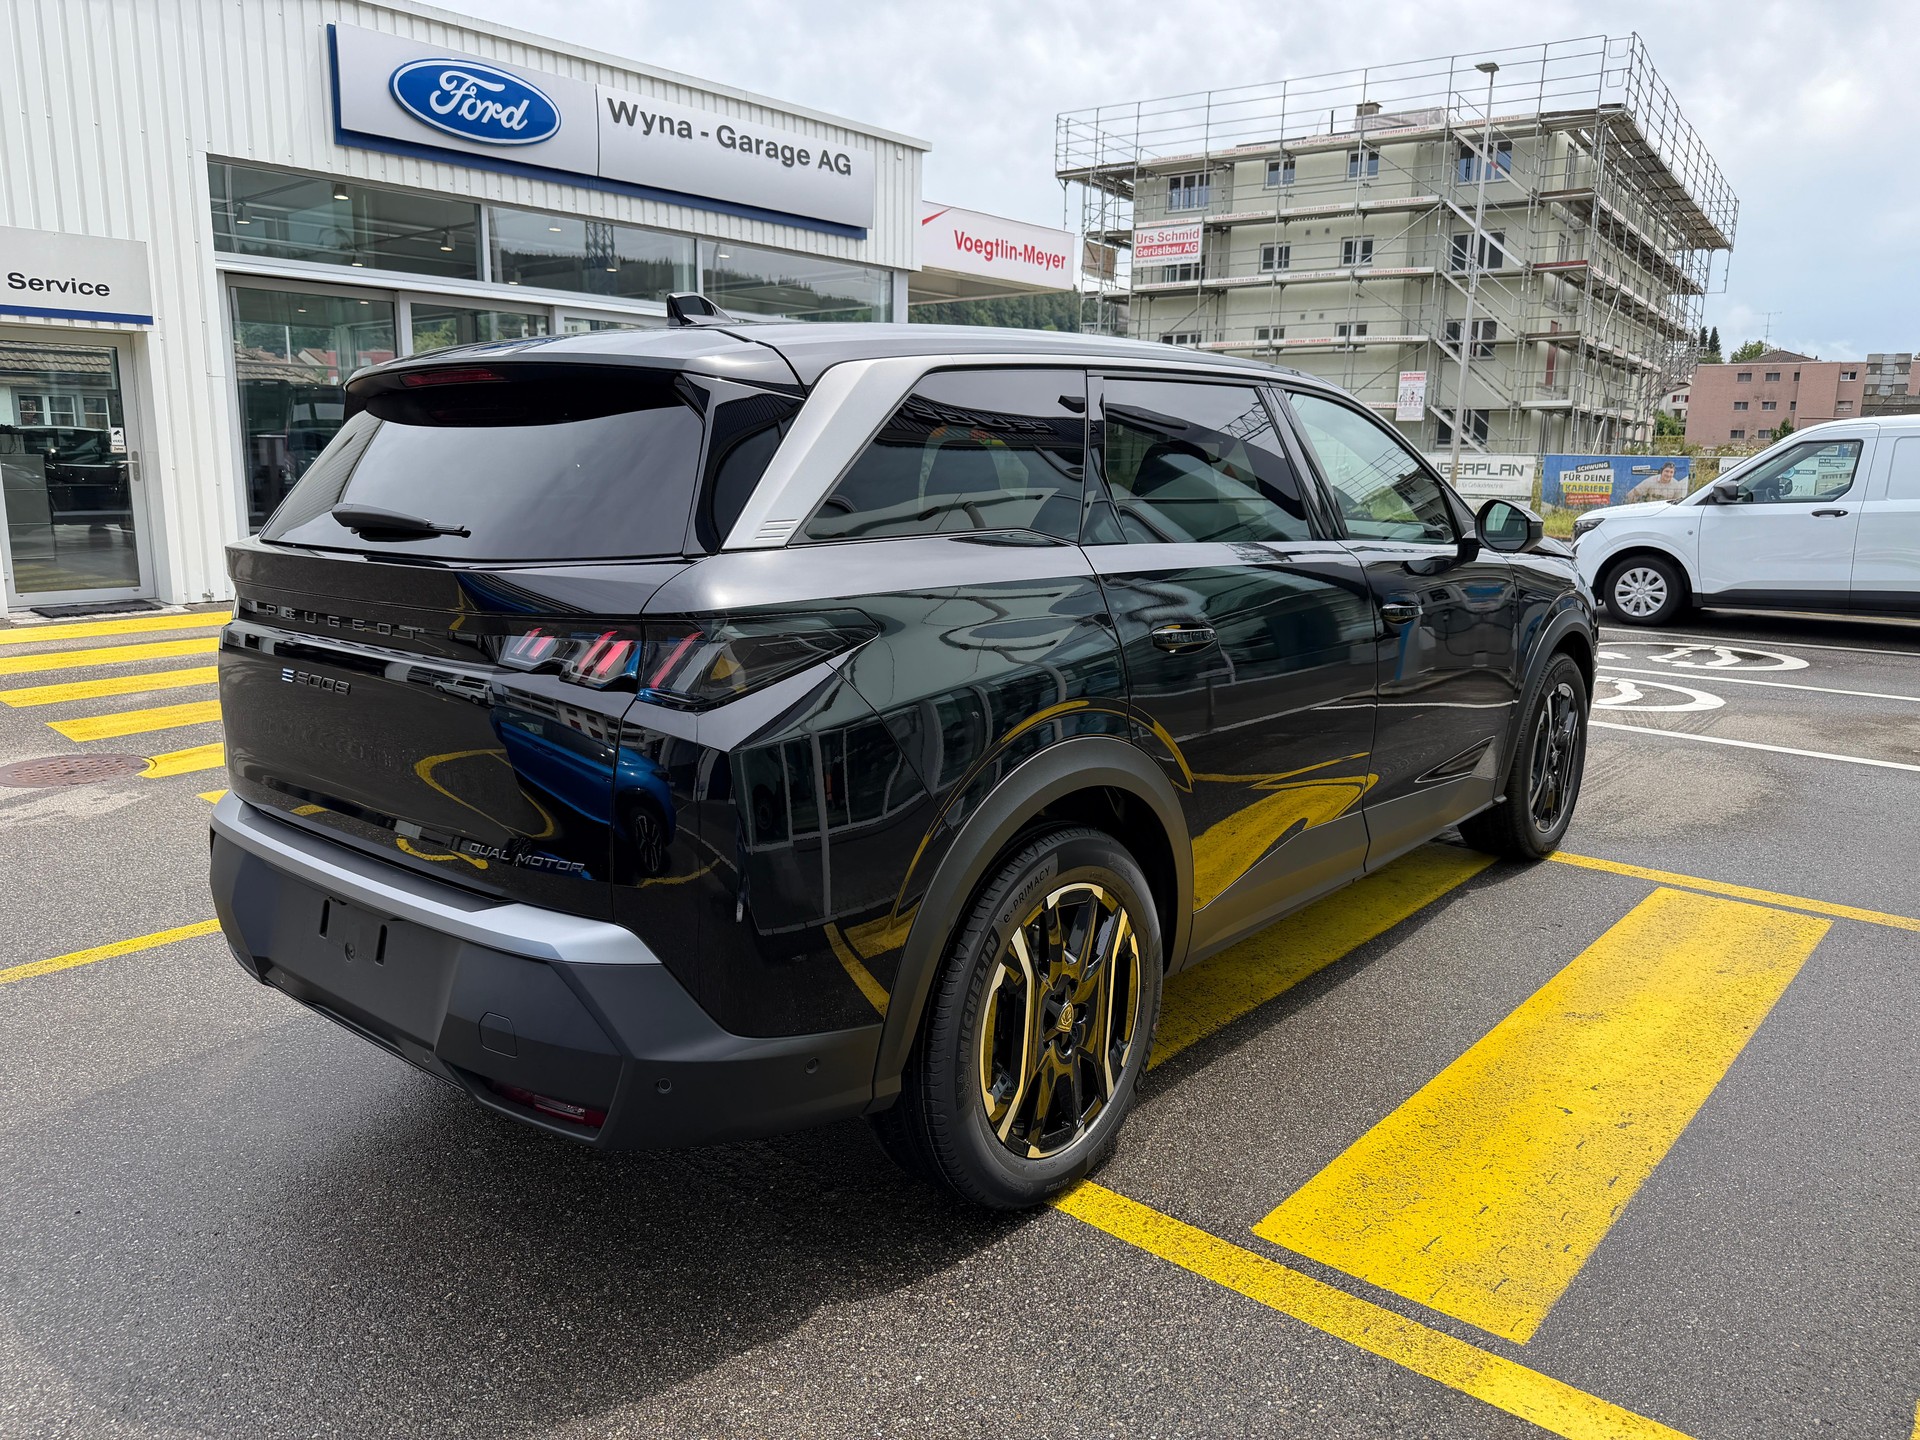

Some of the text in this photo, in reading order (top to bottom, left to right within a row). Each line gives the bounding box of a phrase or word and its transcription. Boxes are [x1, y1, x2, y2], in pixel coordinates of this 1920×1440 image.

[429, 70, 529, 131] Ford
[607, 97, 693, 140] Wyna
[716, 124, 811, 168] Garage
[817, 149, 852, 176] AG
[1136, 228, 1200, 244] Urs Schmid
[954, 229, 1066, 270] Voegtlin-Meyer
[1136, 243, 1198, 257] Gerüstbau AG
[7, 272, 110, 296] Service
[1564, 472, 1581, 482] FÜR
[1578, 462, 1608, 472] SCHWUNG
[1566, 484, 1610, 492] KARRIERE
[266, 605, 424, 640] PEUGEOT
[469, 843, 585, 872] DUAL MOTOR
[957, 927, 1000, 1066] MICHELIN
